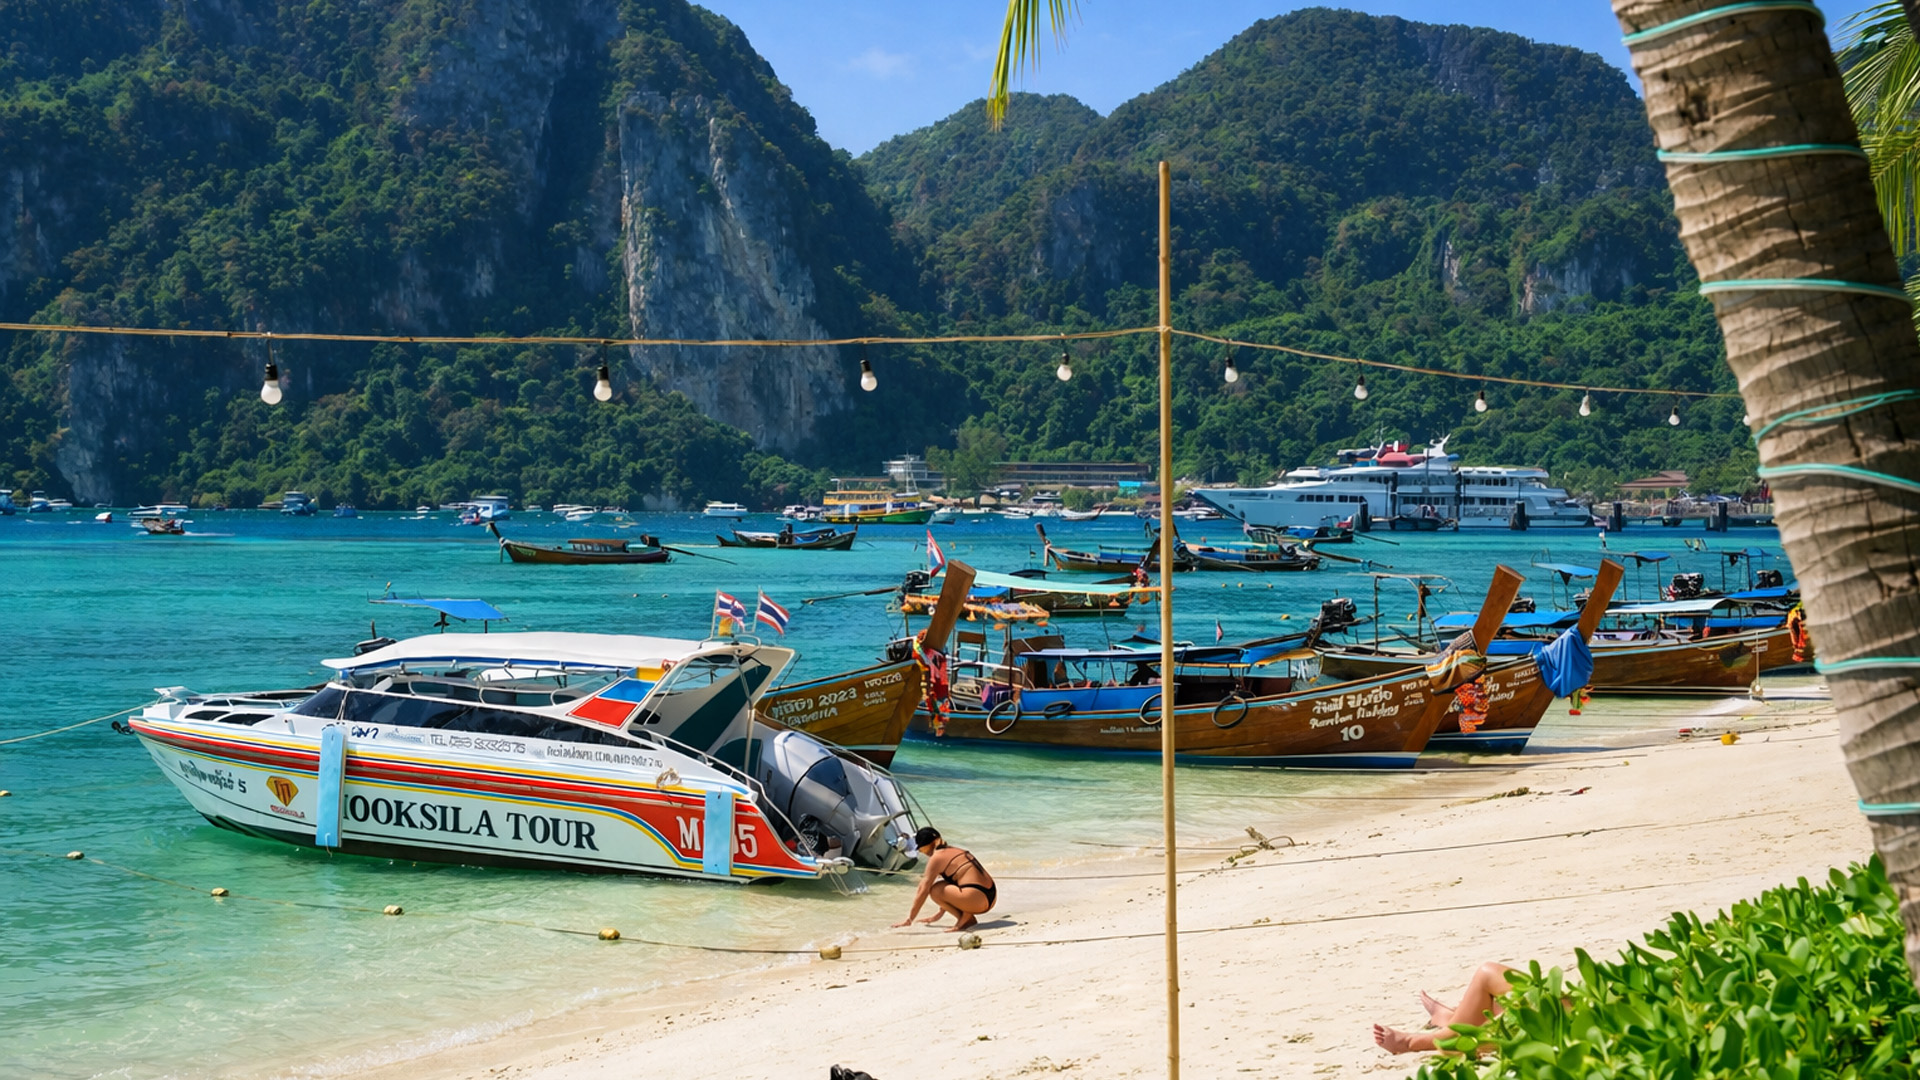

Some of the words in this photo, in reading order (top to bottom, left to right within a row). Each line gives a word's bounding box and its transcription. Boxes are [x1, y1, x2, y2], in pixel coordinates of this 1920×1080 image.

[819, 687, 857, 707] 2023
[1340, 724, 1364, 741] 10
[238, 778, 247, 793] 5
[506, 812, 600, 851] TOUR
